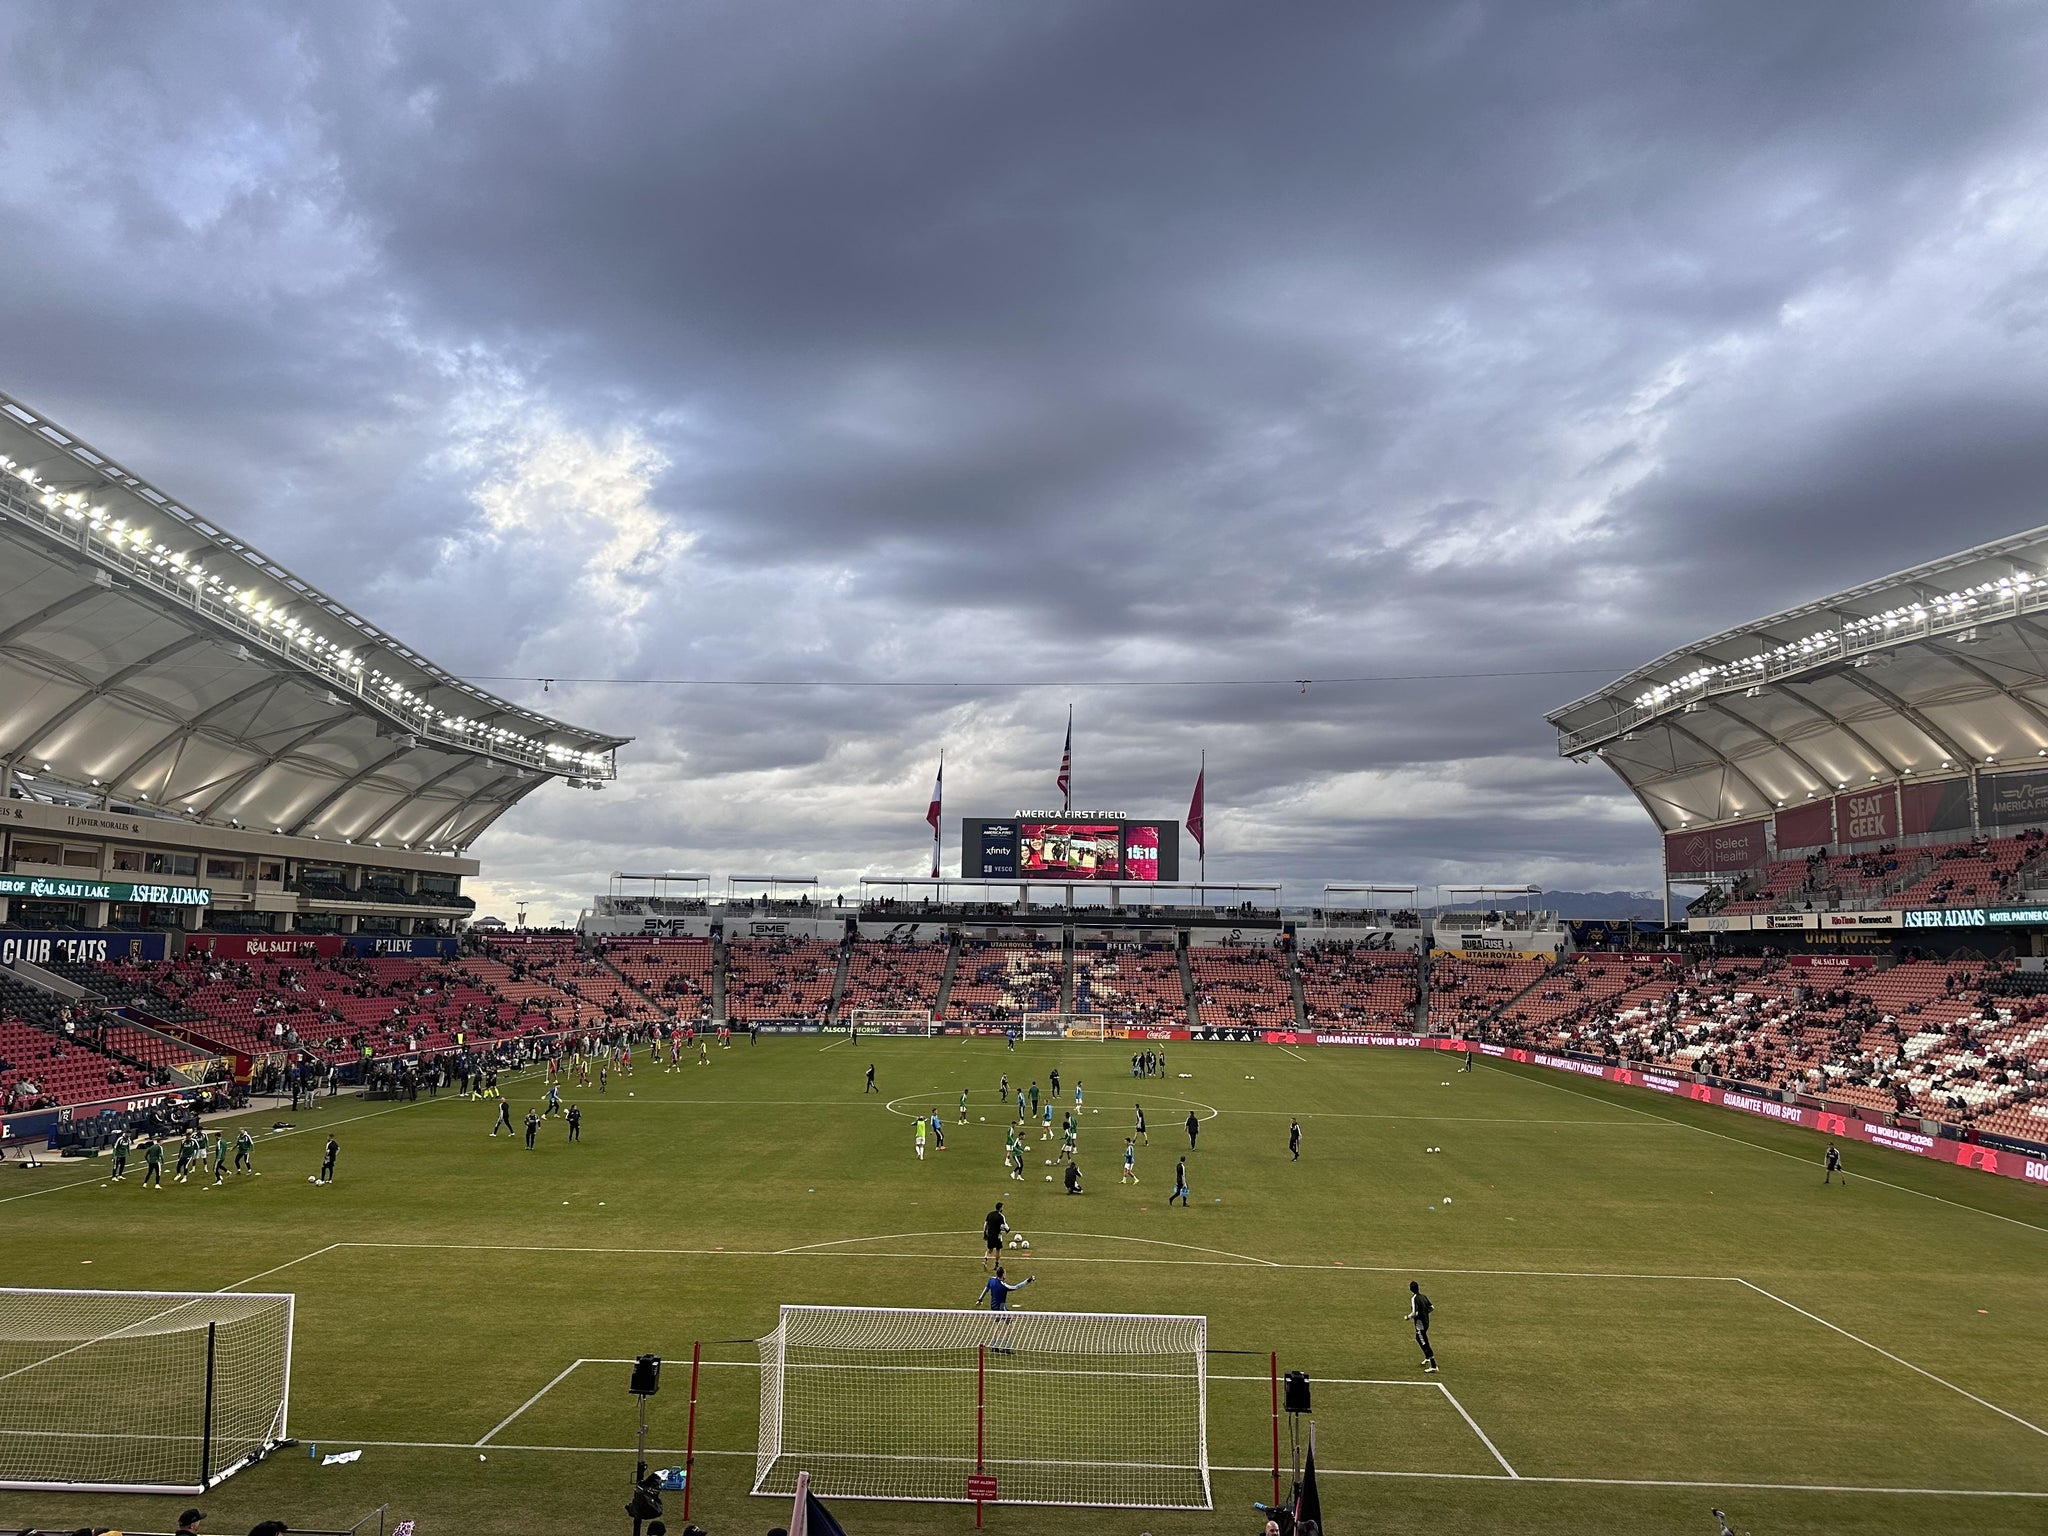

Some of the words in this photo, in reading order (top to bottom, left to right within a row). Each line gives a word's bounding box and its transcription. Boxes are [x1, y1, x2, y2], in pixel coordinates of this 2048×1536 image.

[1850, 794, 1883, 819] SEAT
[1992, 800, 2034, 813] AMERICA
[1014, 810, 1062, 819] AMERICA
[1065, 810, 1095, 819] FIRST
[1098, 811, 1127, 819] FIELD
[76, 817, 98, 827] JAVIER
[100, 820, 129, 831] MORALES
[1850, 815, 1886, 839] GEEK
[1715, 836, 1749, 850] Select
[985, 846, 1011, 856] xfinity
[1715, 850, 1749, 863] Health
[57, 883, 84, 897] SALT
[85, 886, 110, 898] LAKE
[129, 885, 171, 903] ASHER
[167, 888, 210, 905] ADAMS
[644, 919, 685, 930] SME
[1858, 915, 1893, 925] Kennecott
[1905, 911, 1943, 927] ASHER
[1944, 909, 1985, 926] ADAMS
[1989, 912, 2012, 922] HOTEL
[2011, 910, 2043, 921] PARTNER
[755, 925, 785, 933] SME
[1484, 938, 1502, 949] FUSE
[1804, 931, 1837, 944] UTAH
[3, 938, 51, 965] CLUB
[270, 941, 292, 952] SALT
[1466, 951, 1490, 959] UTAH
[1491, 951, 1523, 960] ROYALS
[1823, 958, 1835, 966] SALT
[1836, 958, 1850, 966] LAKE
[1316, 1034, 1369, 1045] GUARANTEE
[1370, 1036, 1395, 1046] YOUR
[1397, 1037, 1421, 1047] SPOT
[1580, 1062, 1604, 1076] PACKAGE
[1723, 1092, 1761, 1112] GUARANTEE
[1761, 1102, 1781, 1117] YOUR
[1781, 1105, 1802, 1122] SPOT
[1865, 1123, 1878, 1136] FIFA
[1878, 1126, 1898, 1139] WORLD
[1898, 1129, 1911, 1141] CUP
[1911, 1132, 1934, 1148] 2026
